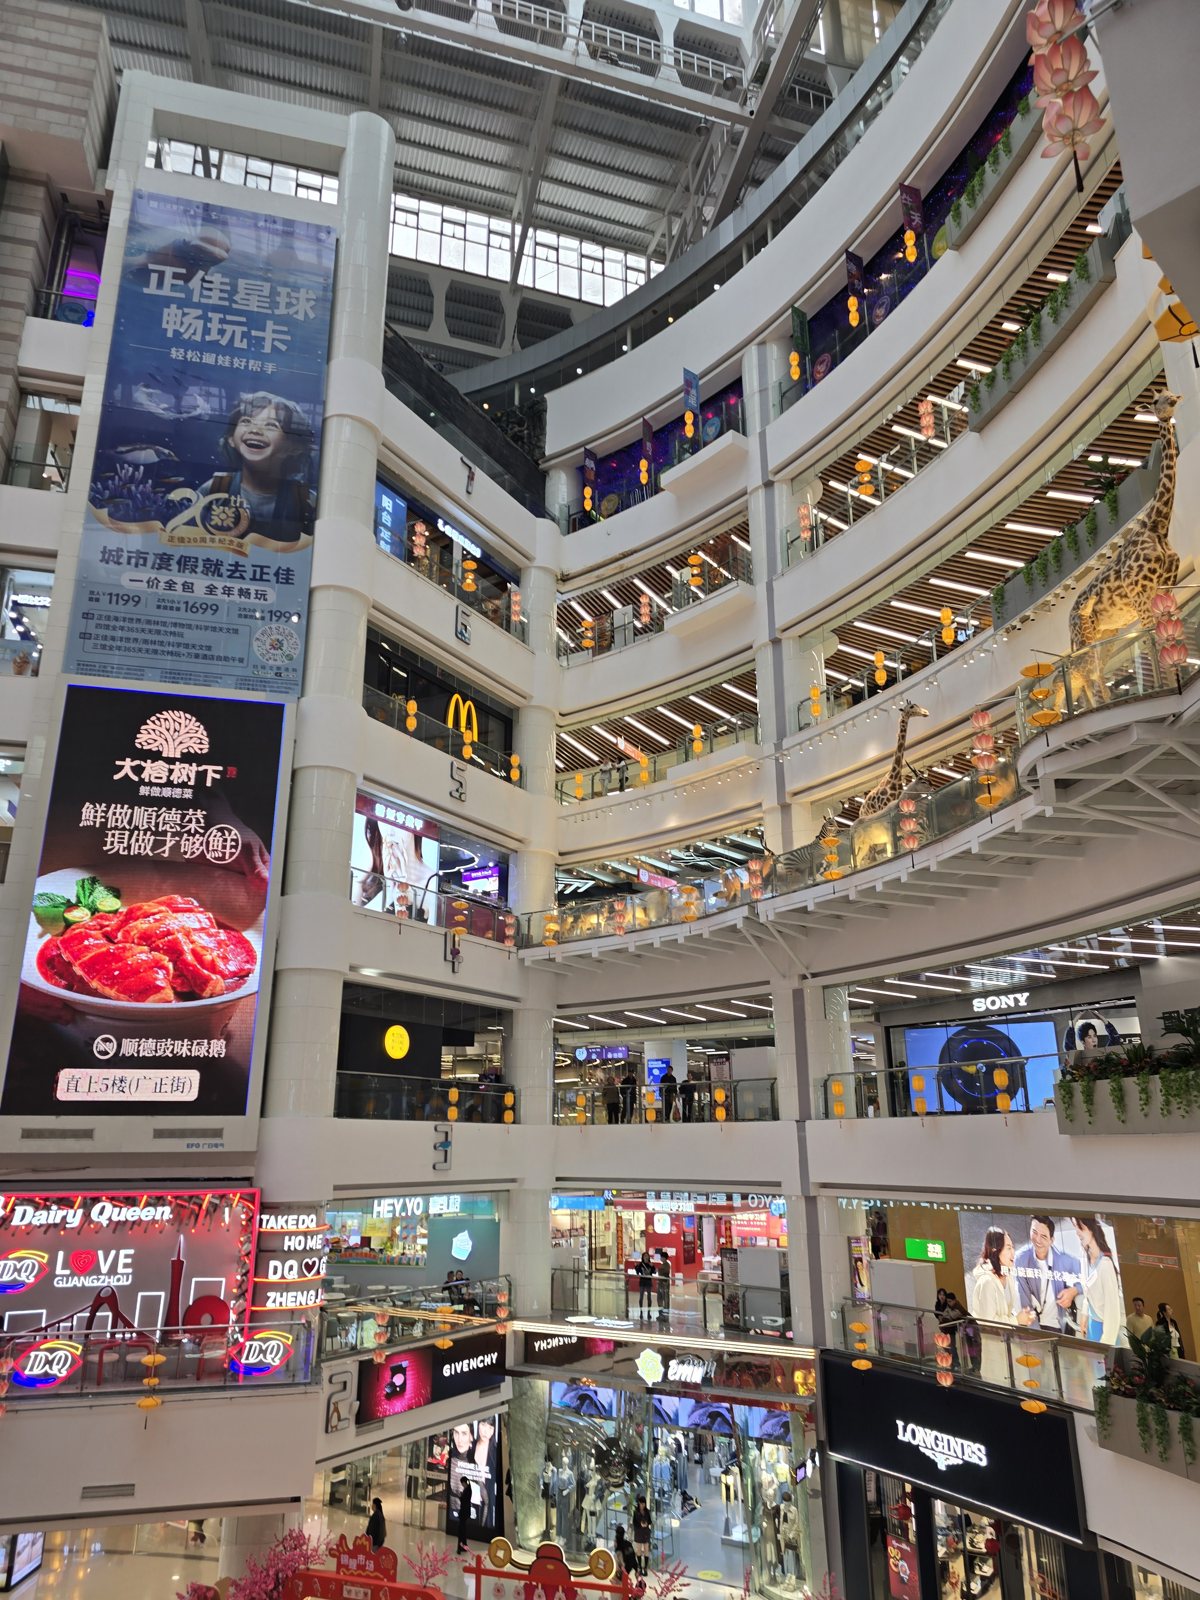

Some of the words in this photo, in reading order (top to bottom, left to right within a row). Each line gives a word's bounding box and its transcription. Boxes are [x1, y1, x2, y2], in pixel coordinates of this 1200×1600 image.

[143, 263, 317, 321] 正佳星球
[162, 304, 291, 354] 畅玩卡
[170, 347, 277, 374] 轻松遛娃好帮手
[100, 546, 295, 585] 城市度假就去正佳
[128, 576, 196, 594] 一价全包
[203, 584, 268, 601] 全年畅玩
[113, 758, 223, 787] 大榕树下
[79, 802, 207, 834] 鮮做順德菜
[972, 992, 1030, 1012] SONY
[119, 1038, 226, 1058] 顺德豉味碌鹅
[11, 1205, 83, 1228] Dairy
[90, 1202, 171, 1223] Queen
[372, 1196, 423, 1219] HEY.YO
[284, 1234, 323, 1251] HOME
[0, 1260, 39, 1282] DQ
[53, 1275, 133, 1287] GUANGZHOU
[268, 1259, 298, 1279] DQ
[24, 1350, 72, 1376] DQ
[242, 1340, 284, 1364] DQ
[442, 1352, 499, 1377] GIVENCHY
[326, 1370, 354, 1434] 2
[895, 1419, 988, 1467] LONGINES
